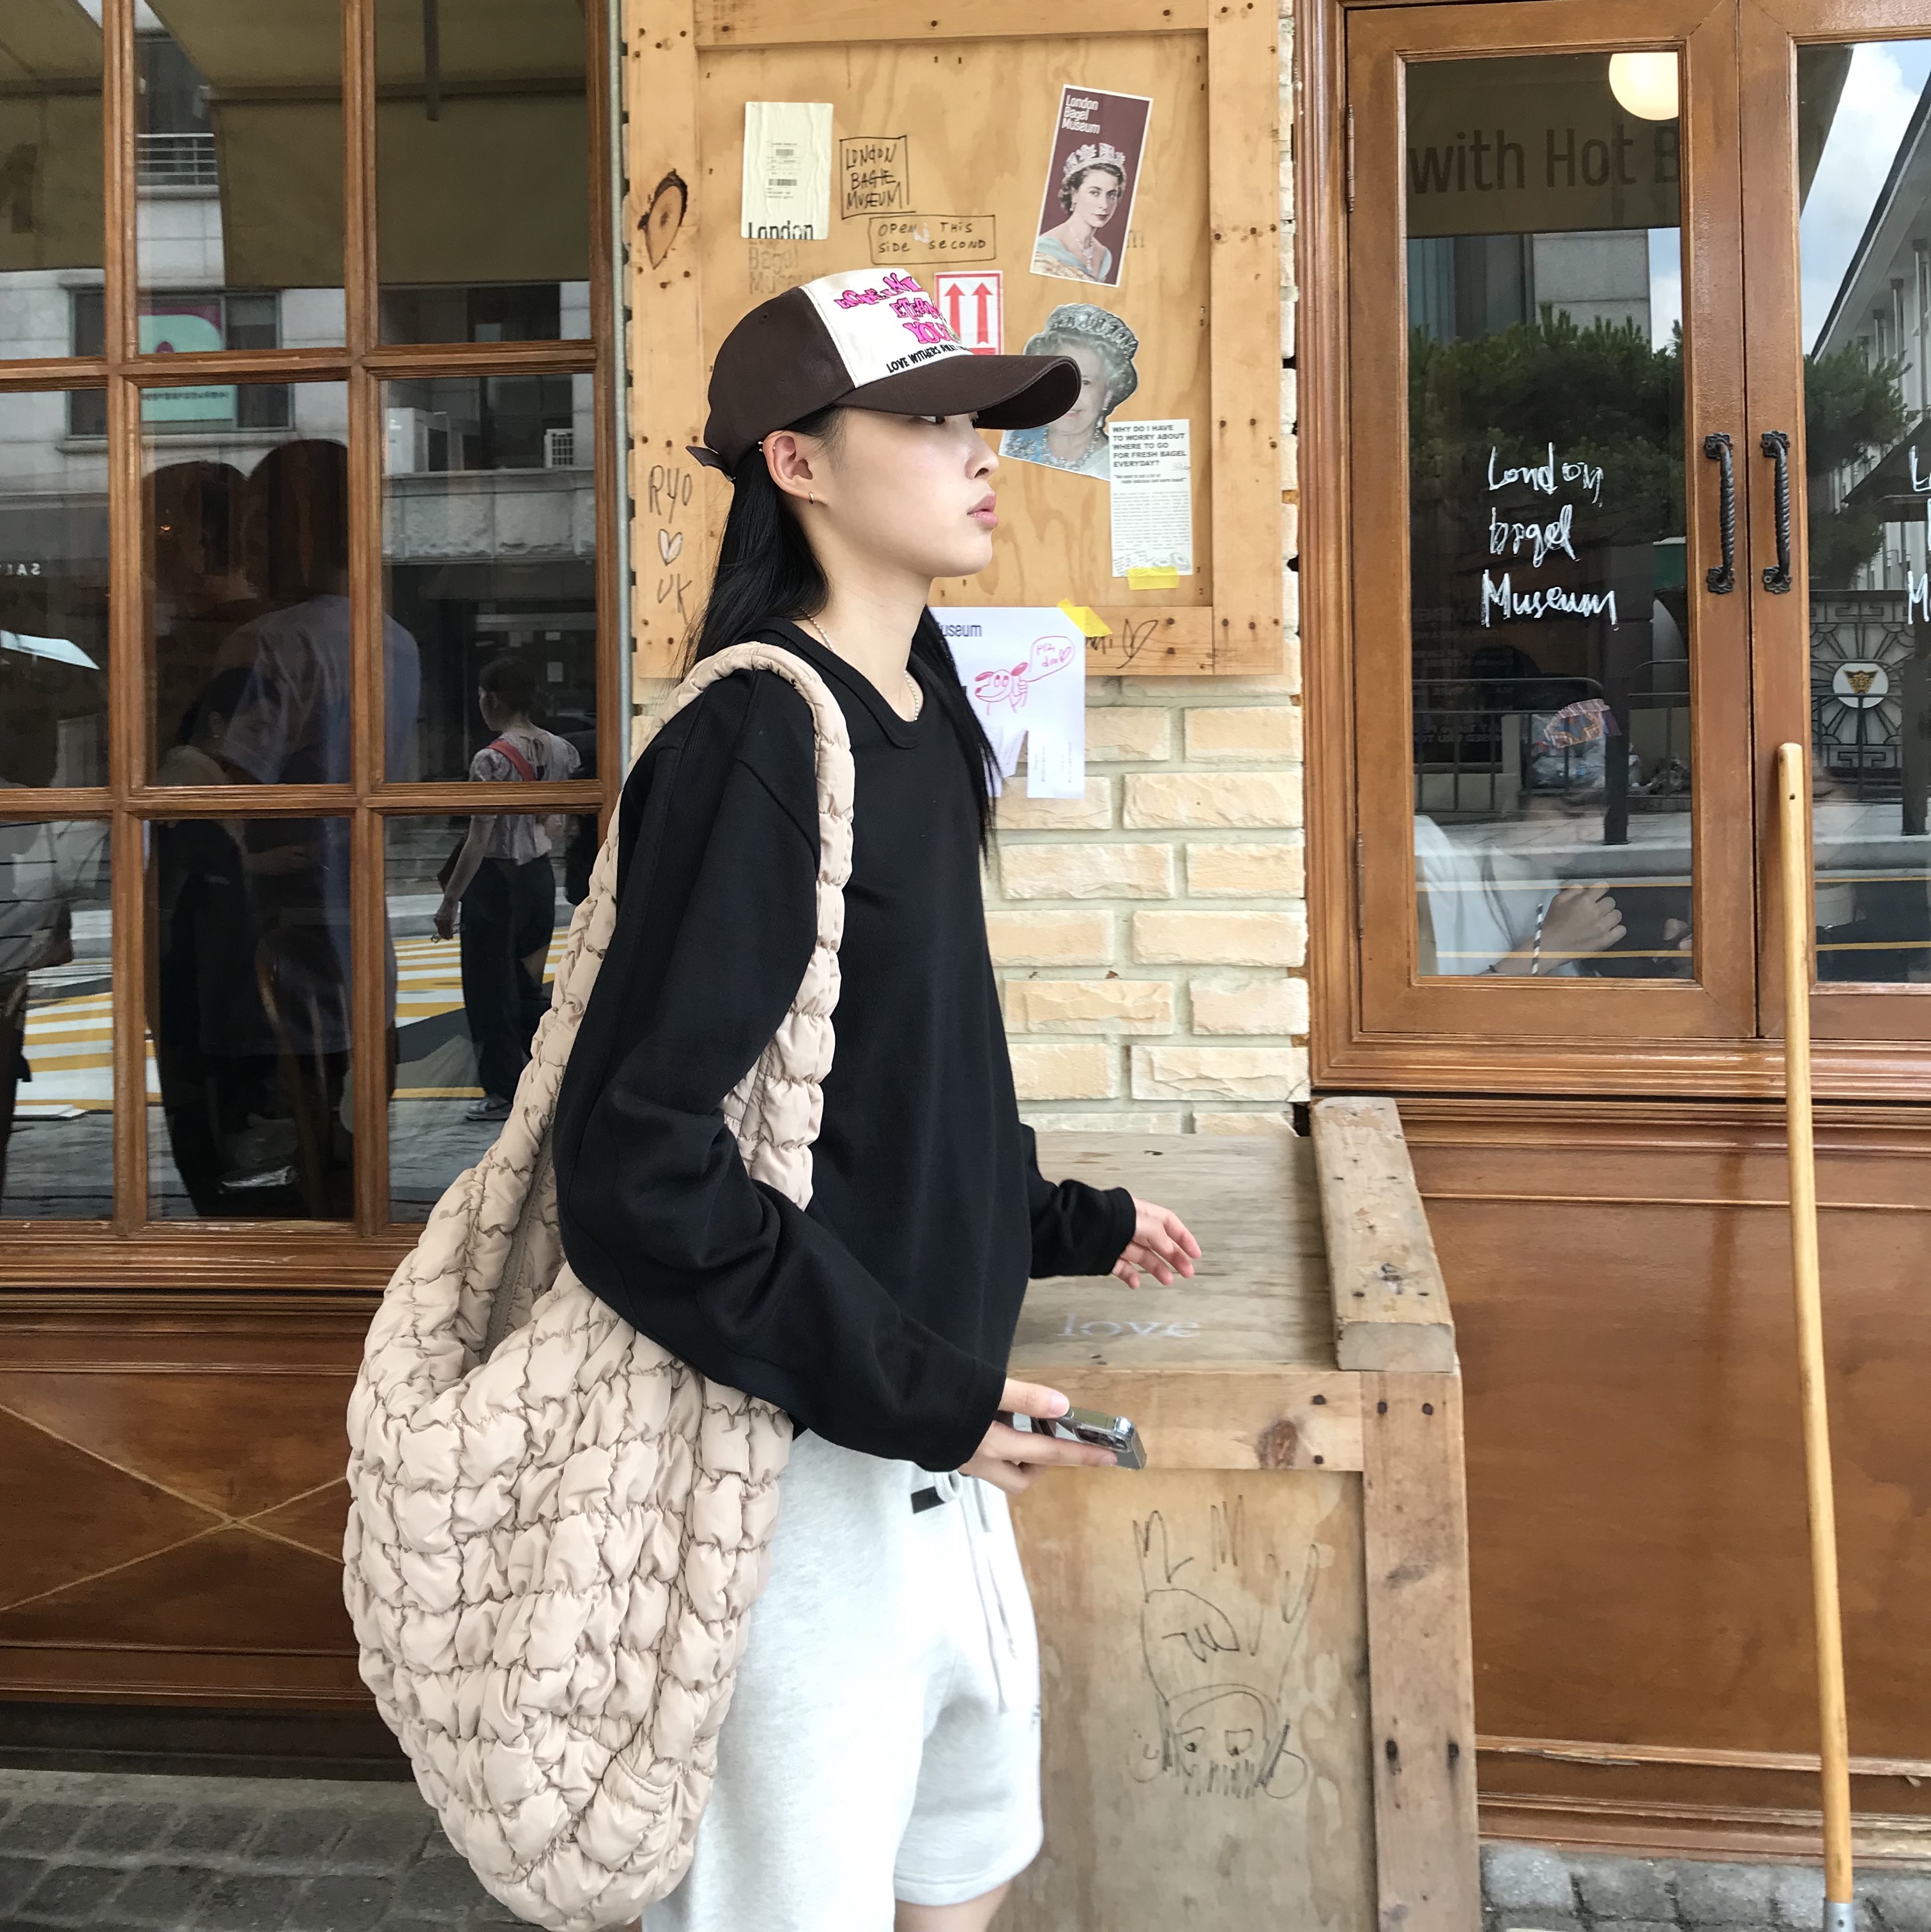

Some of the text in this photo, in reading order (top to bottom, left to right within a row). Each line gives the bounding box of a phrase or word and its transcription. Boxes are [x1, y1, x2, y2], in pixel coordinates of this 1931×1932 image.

[1064, 107, 1090, 121] Bagel
[1065, 95, 1099, 111] London
[1062, 118, 1101, 134] Museum
[1408, 129, 1525, 194] with
[1546, 123, 1637, 187] Hot
[886, 357, 910, 373] LOVE
[908, 345, 942, 364] WITHERS
[1488, 441, 1604, 507] London
[1481, 569, 1619, 631] Museum
[939, 624, 982, 637] useum
[1057, 1313, 1203, 1338] love
